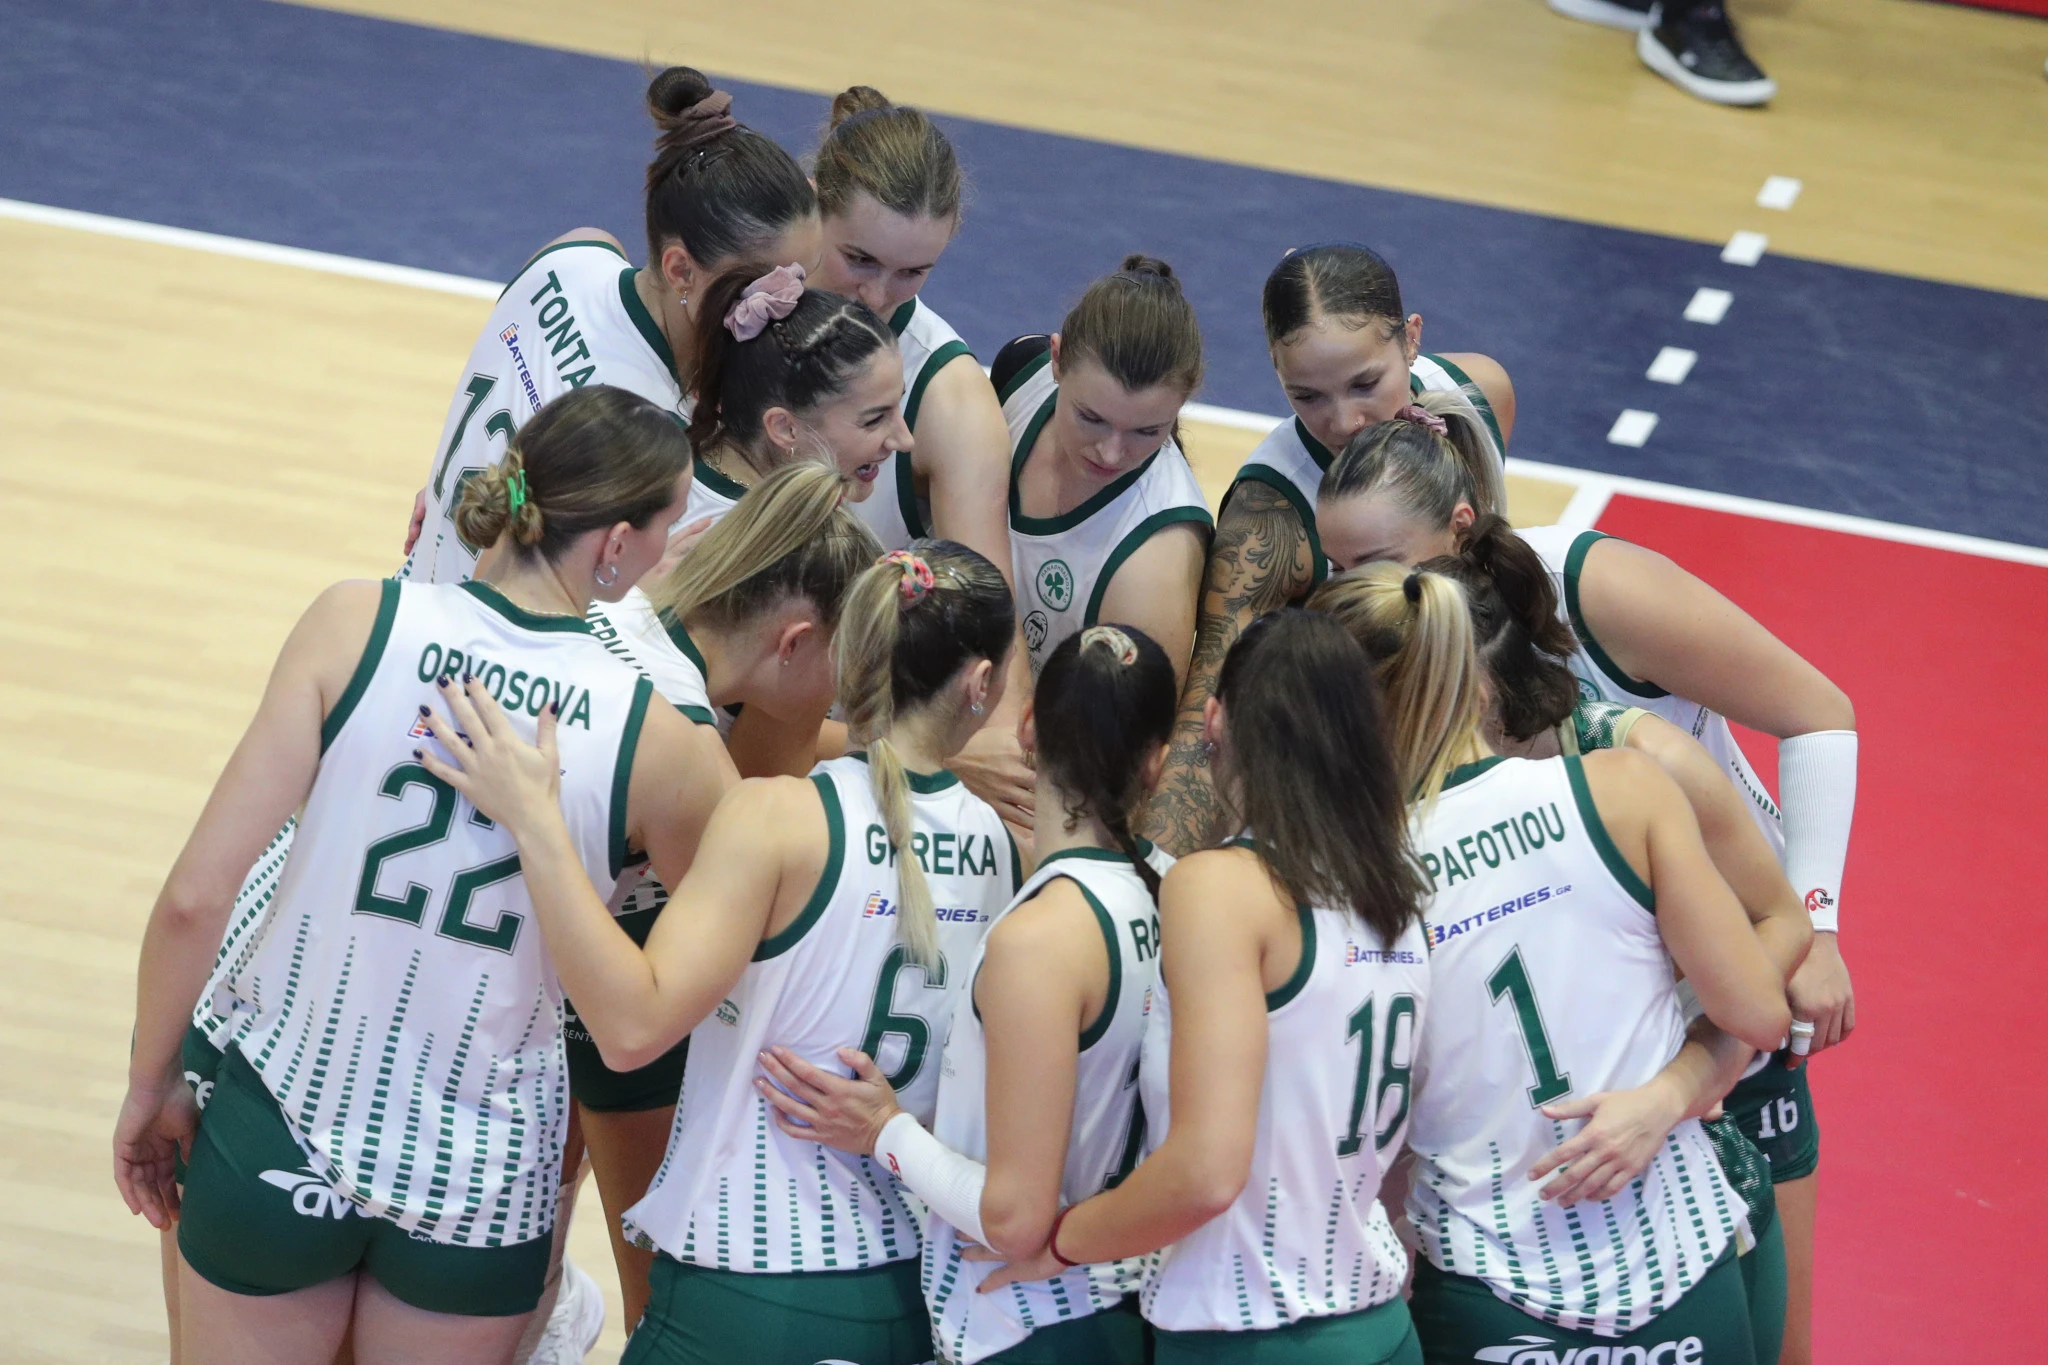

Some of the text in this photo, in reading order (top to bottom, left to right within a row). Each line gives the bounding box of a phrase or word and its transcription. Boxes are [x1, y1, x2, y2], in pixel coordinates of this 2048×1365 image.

[351, 759, 526, 956] 22
[856, 943, 948, 1093] 6
[1484, 943, 1573, 1110] 1
